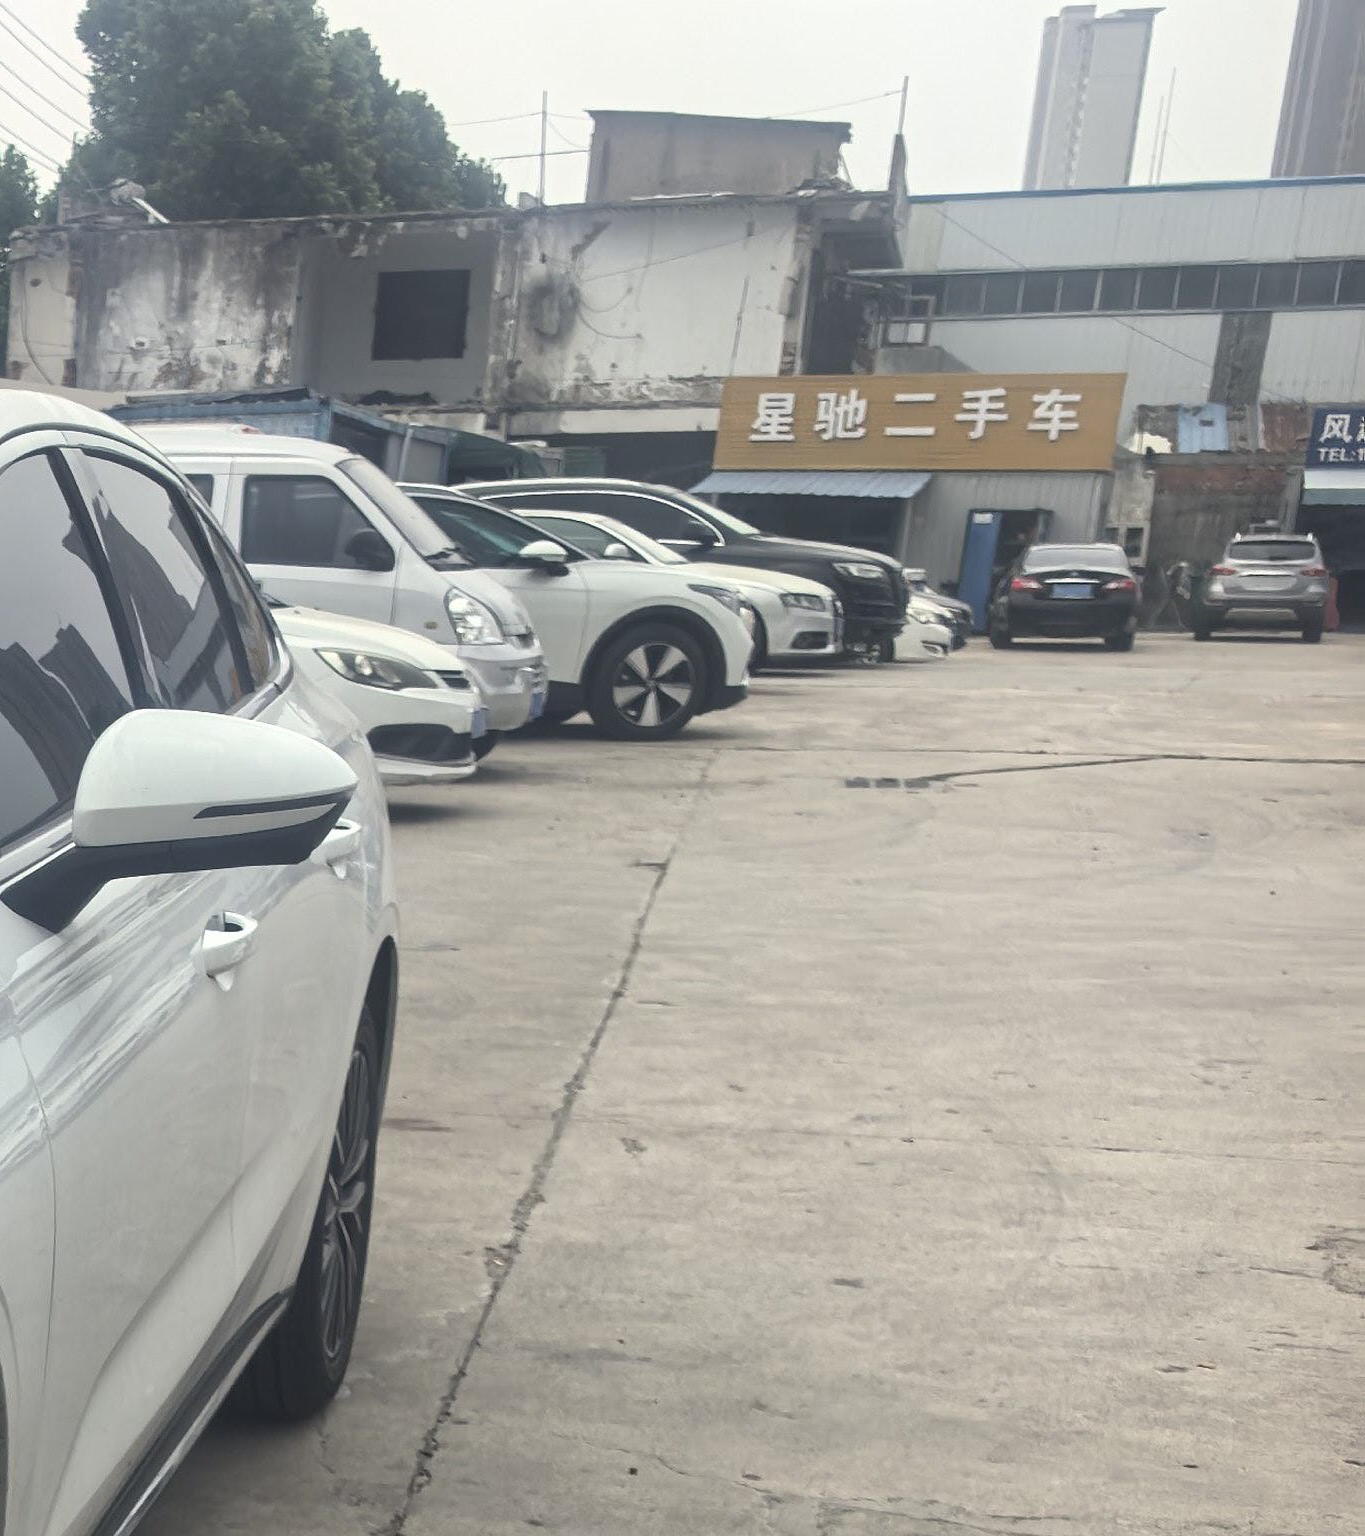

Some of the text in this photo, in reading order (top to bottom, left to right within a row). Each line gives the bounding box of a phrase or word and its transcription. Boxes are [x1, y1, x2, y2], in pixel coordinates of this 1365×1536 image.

[748, 388, 1081, 442] 星驰二手车
[1318, 413, 1365, 443] 风
